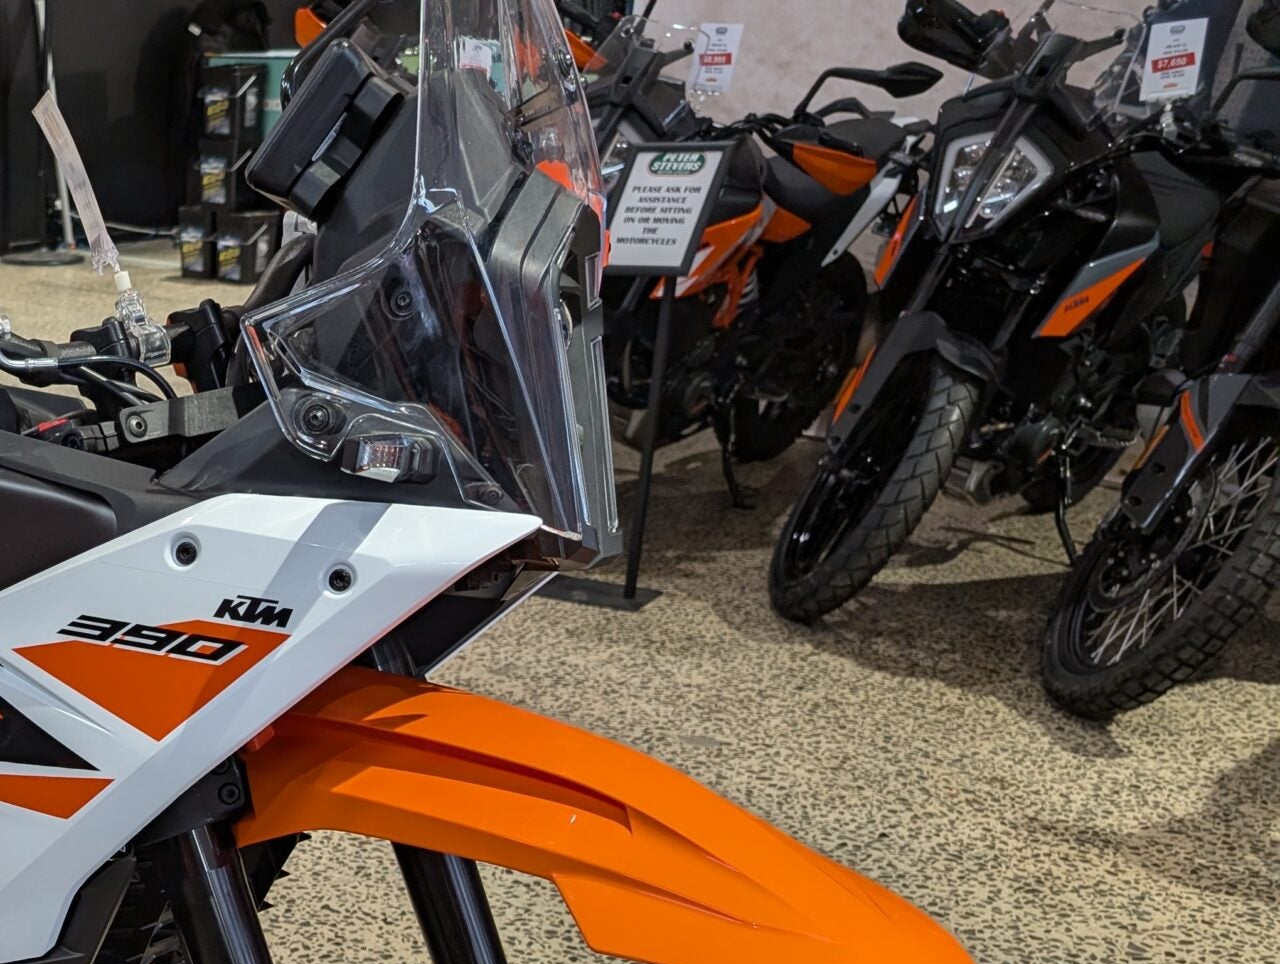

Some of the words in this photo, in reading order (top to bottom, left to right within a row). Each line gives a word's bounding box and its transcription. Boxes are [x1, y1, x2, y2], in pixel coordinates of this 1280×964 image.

[651, 161, 702, 171] STEVENS
[632, 186, 663, 194] PLEASE
[637, 196, 688, 204] ASSISTANCE
[624, 206, 657, 214] BEFORE
[624, 216, 637, 224] ON
[653, 217, 686, 225] MOVING
[642, 227, 659, 235] THE
[616, 237, 677, 246] MOTORCYCLES
[213, 595, 294, 628] KTM
[56, 614, 248, 662] 390
